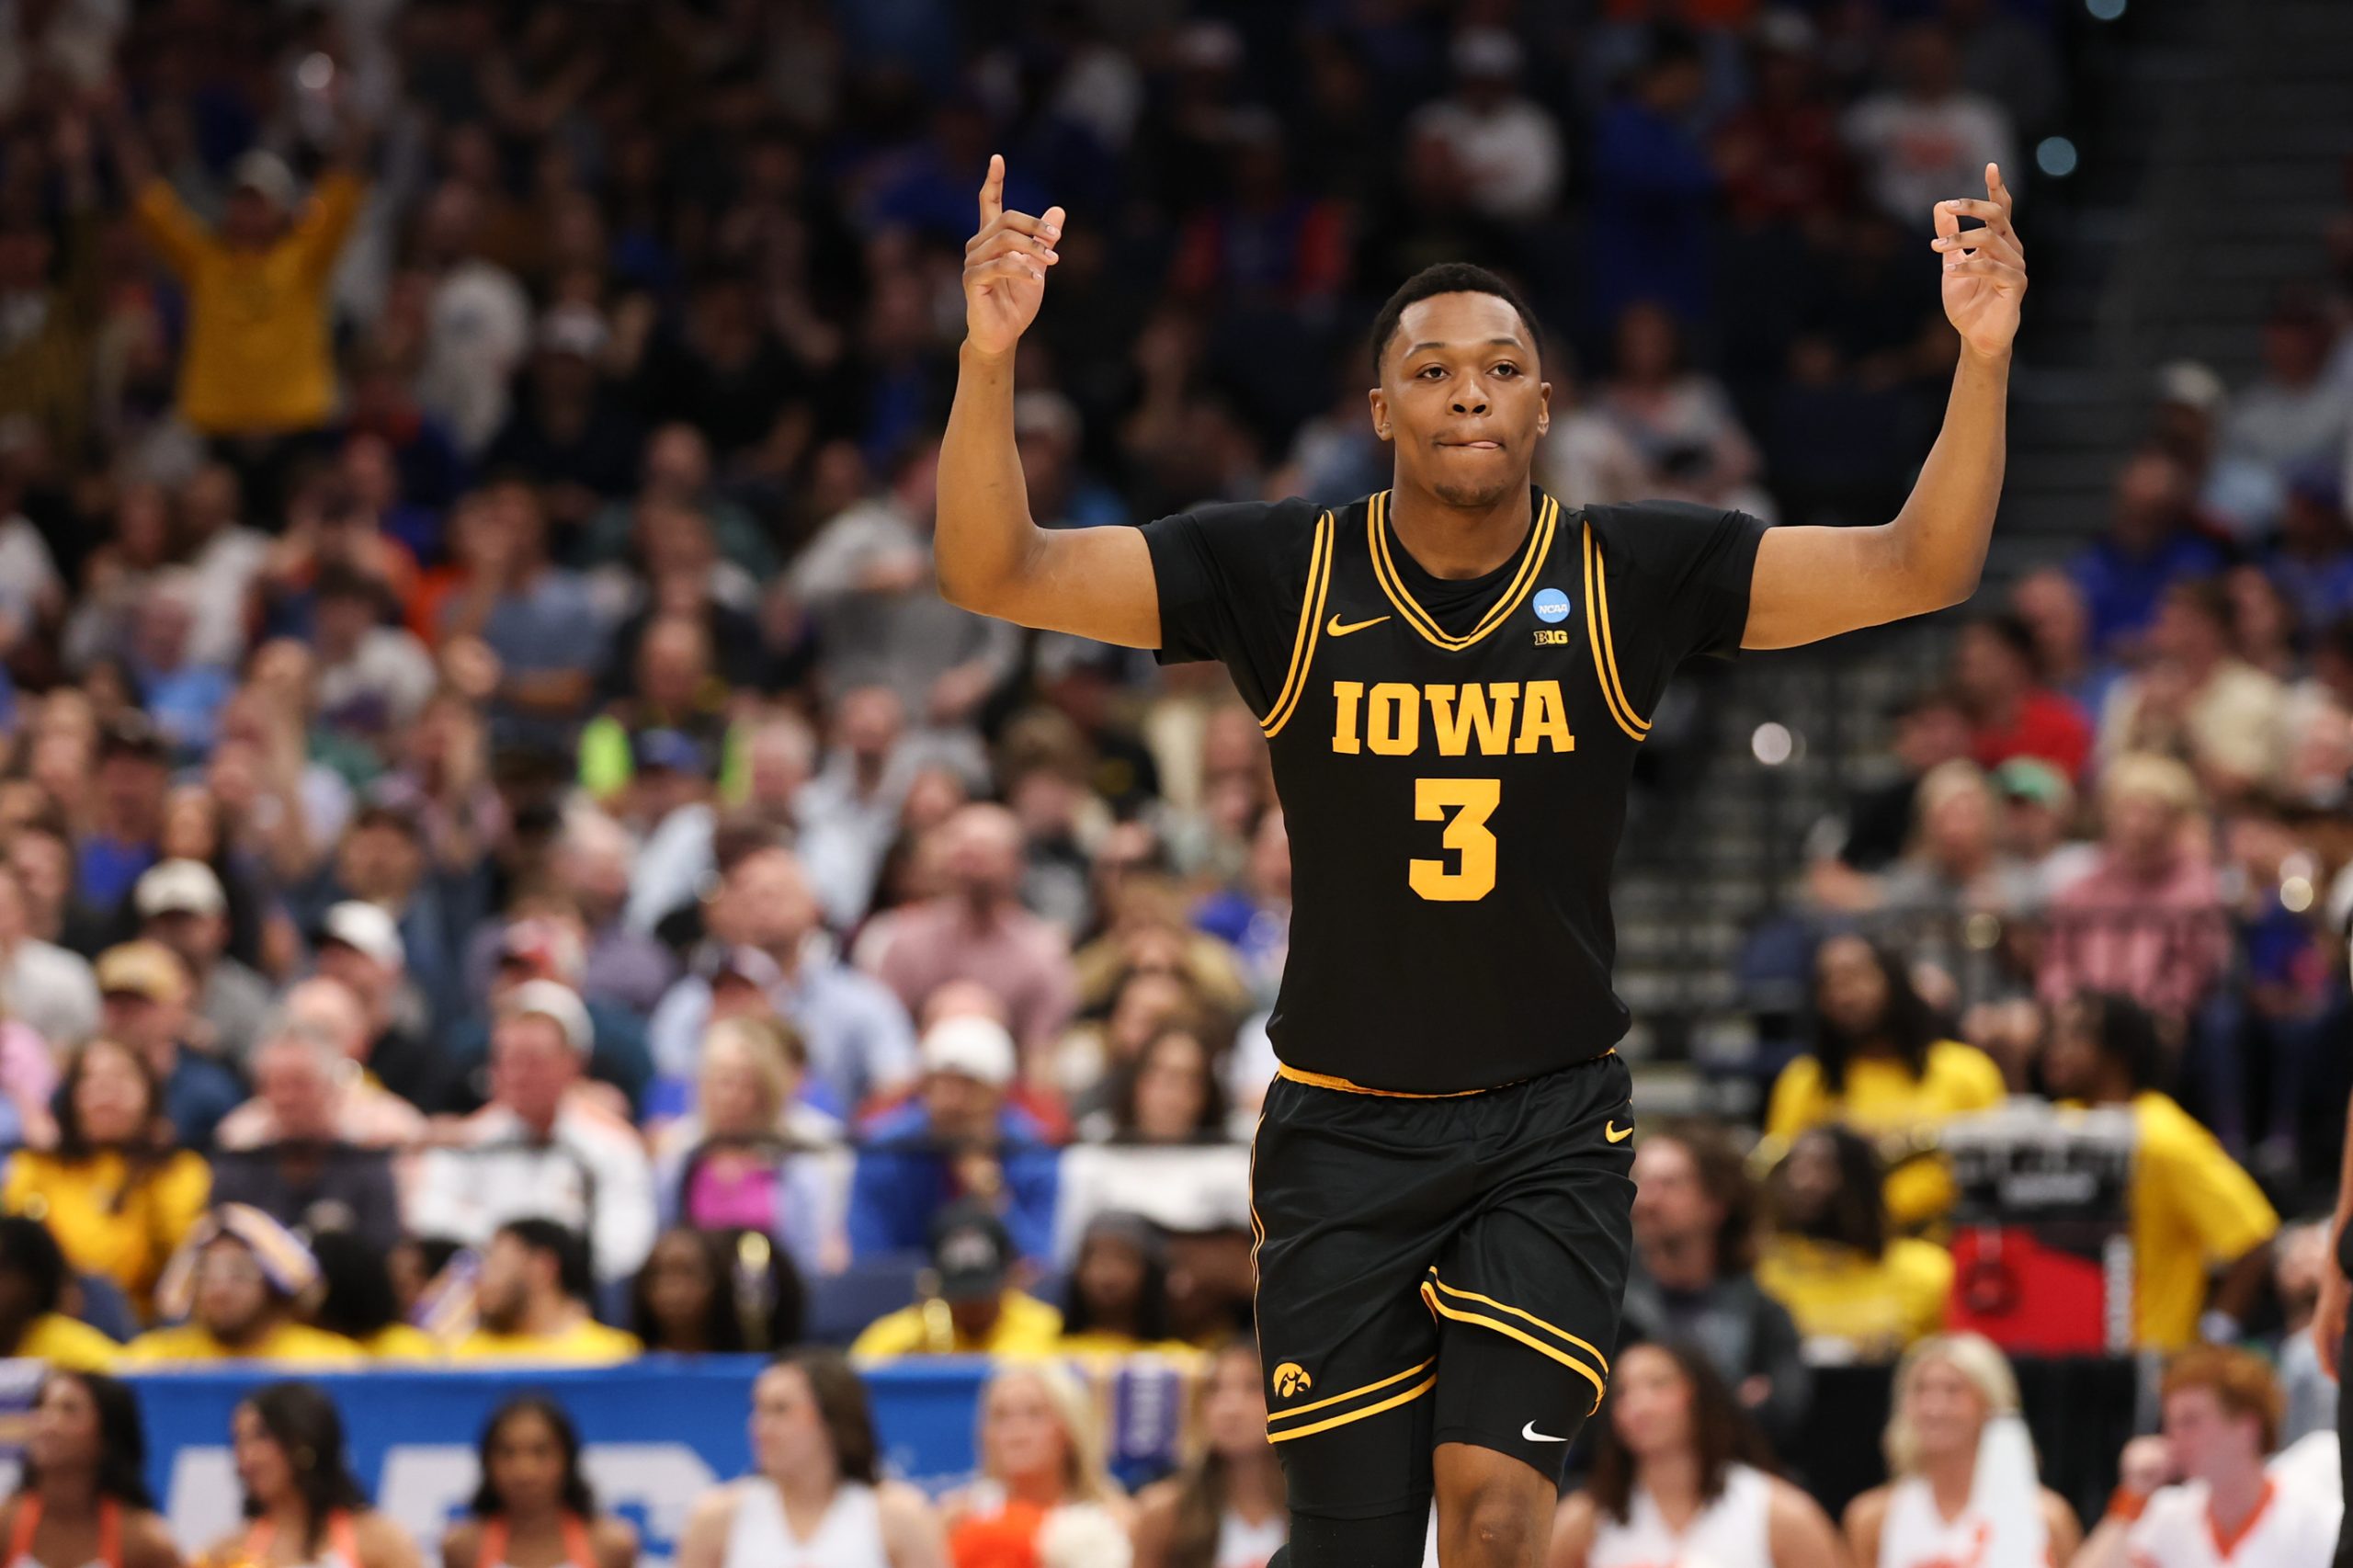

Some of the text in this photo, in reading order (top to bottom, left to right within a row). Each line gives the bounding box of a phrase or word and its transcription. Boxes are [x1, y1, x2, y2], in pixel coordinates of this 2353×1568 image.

[1539, 603, 1568, 614] NCAA
[1332, 680, 1574, 756] IOWA
[1409, 778, 1501, 901] 3
